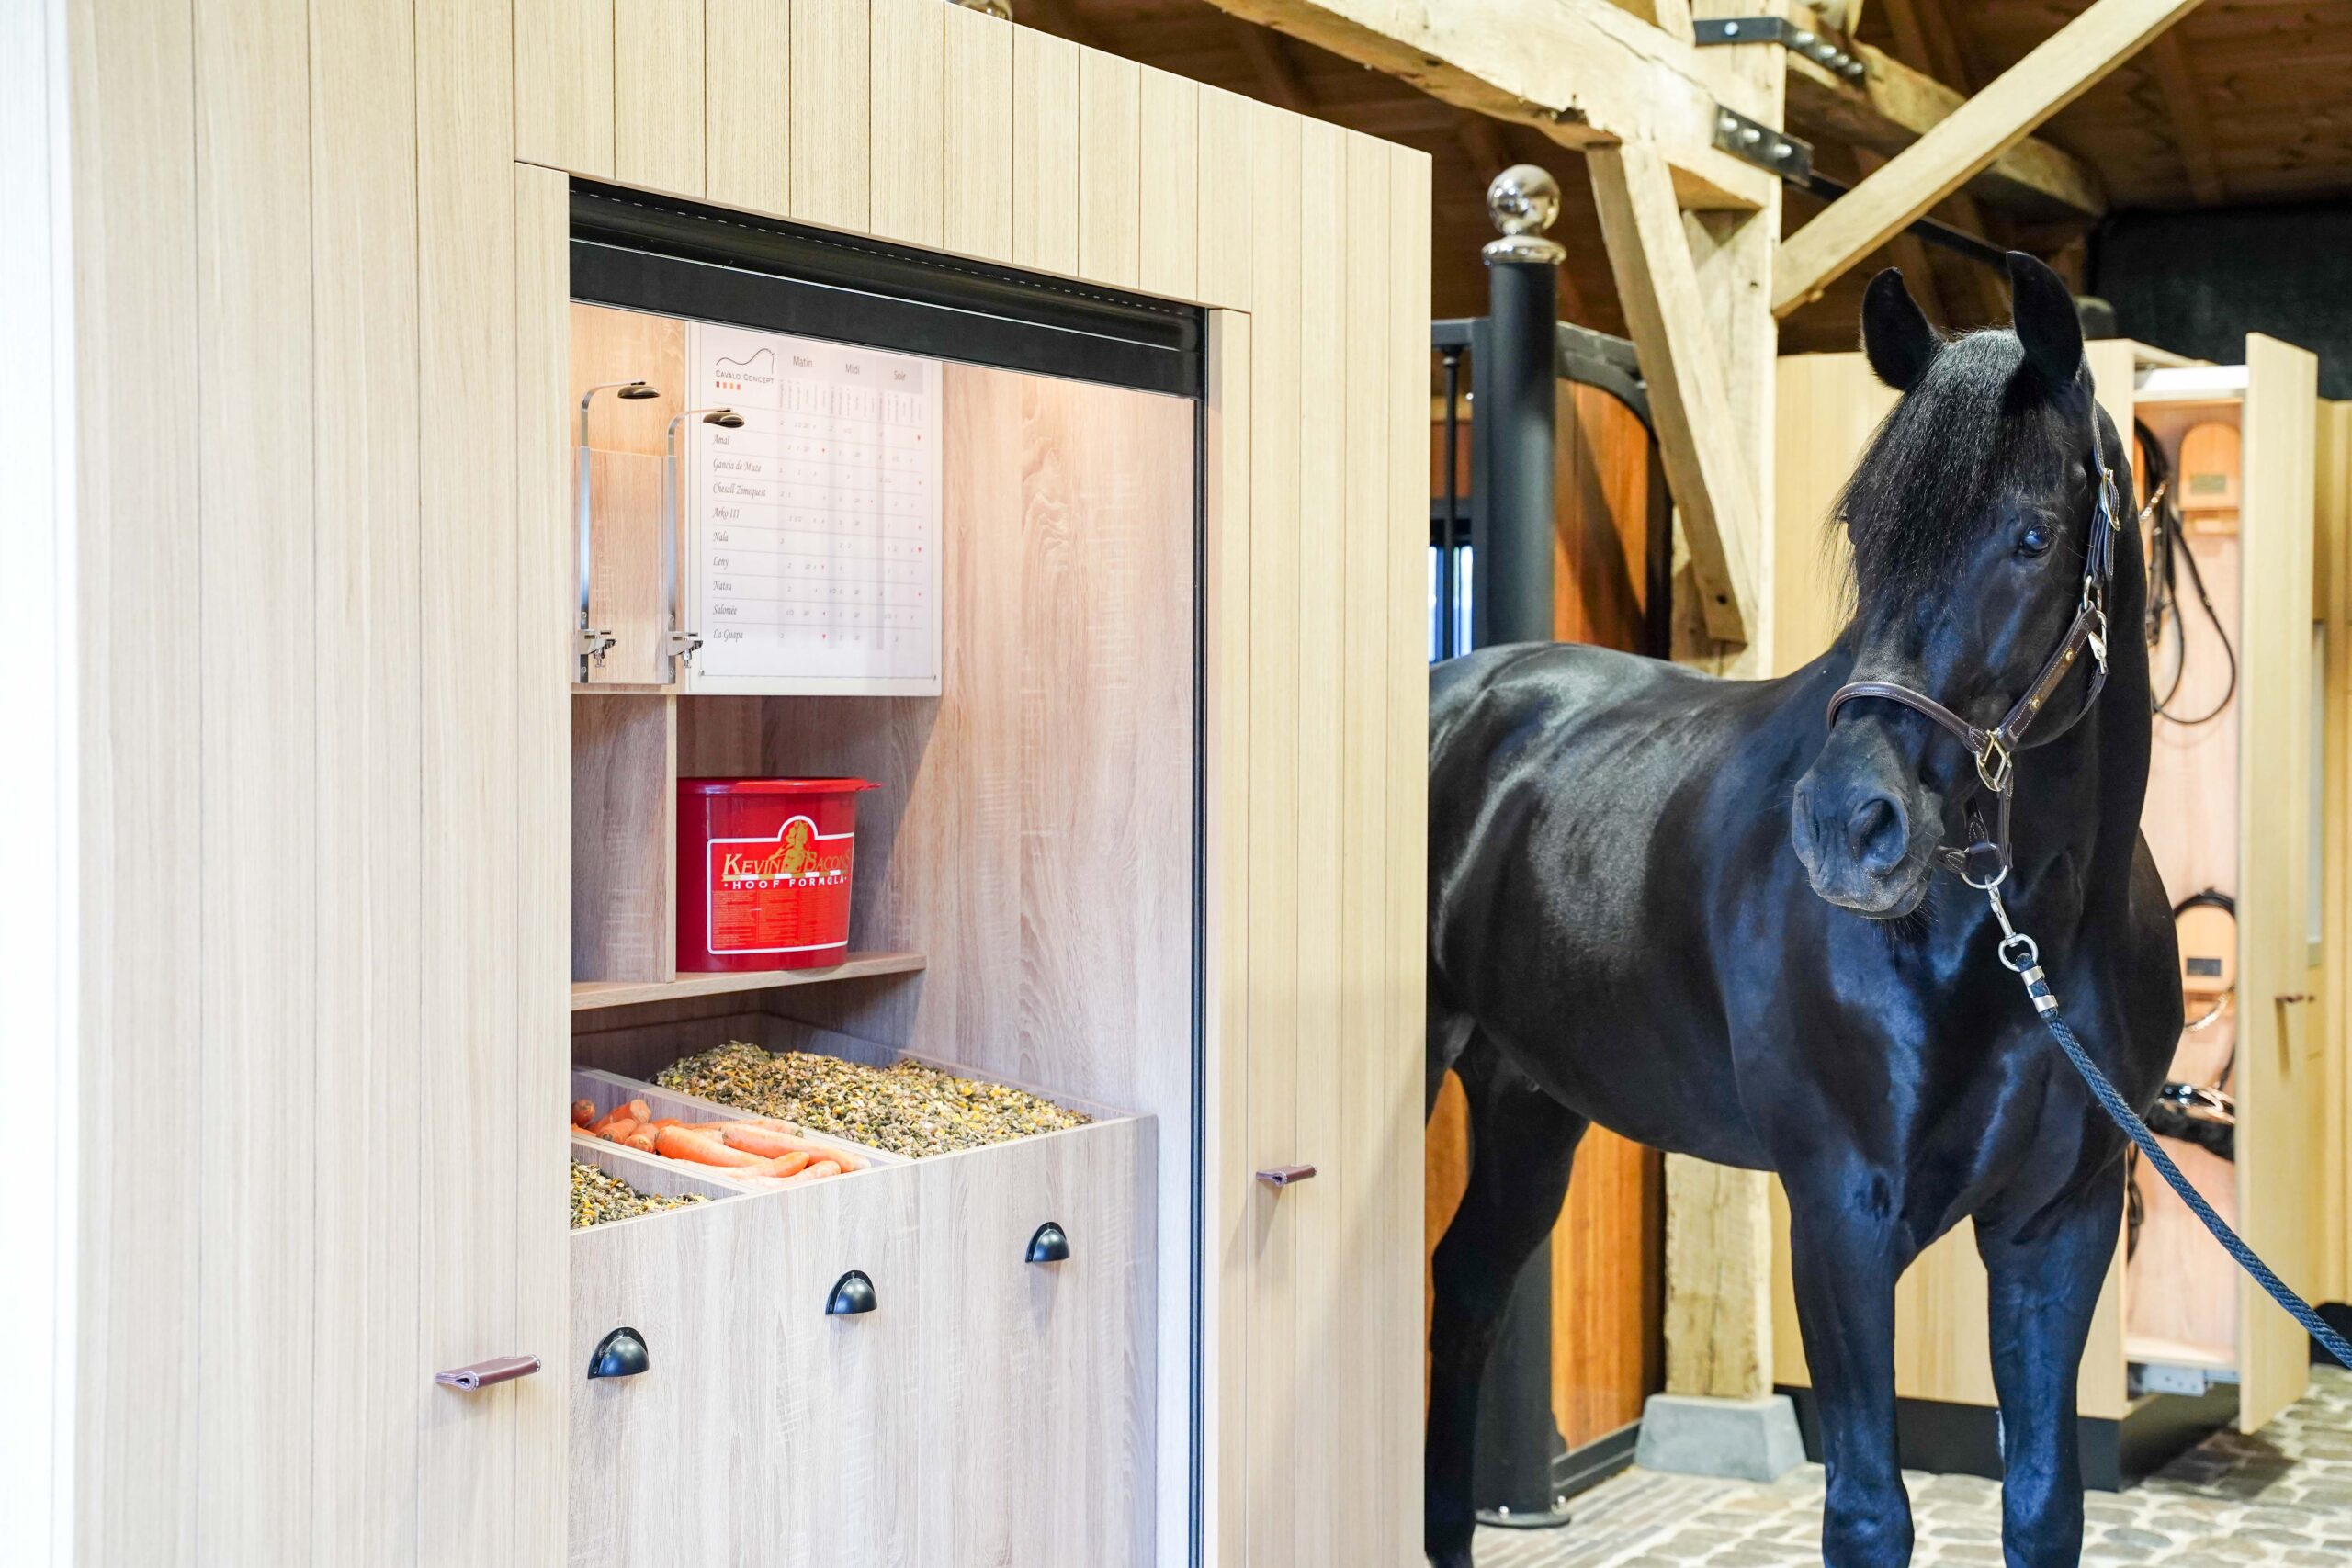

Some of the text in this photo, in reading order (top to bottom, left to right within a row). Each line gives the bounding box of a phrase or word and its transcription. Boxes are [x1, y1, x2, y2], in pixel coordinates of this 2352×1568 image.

[793, 355, 813, 368] Matin
[845, 364, 860, 375] Midi
[893, 370, 907, 381] Soir
[735, 459, 743, 470] de
[713, 531, 729, 542] Nala
[713, 556, 729, 570] Leny
[713, 629, 722, 639] La
[723, 853, 781, 874] KEVIN
[732, 875, 845, 890] HOOF FORMULA
